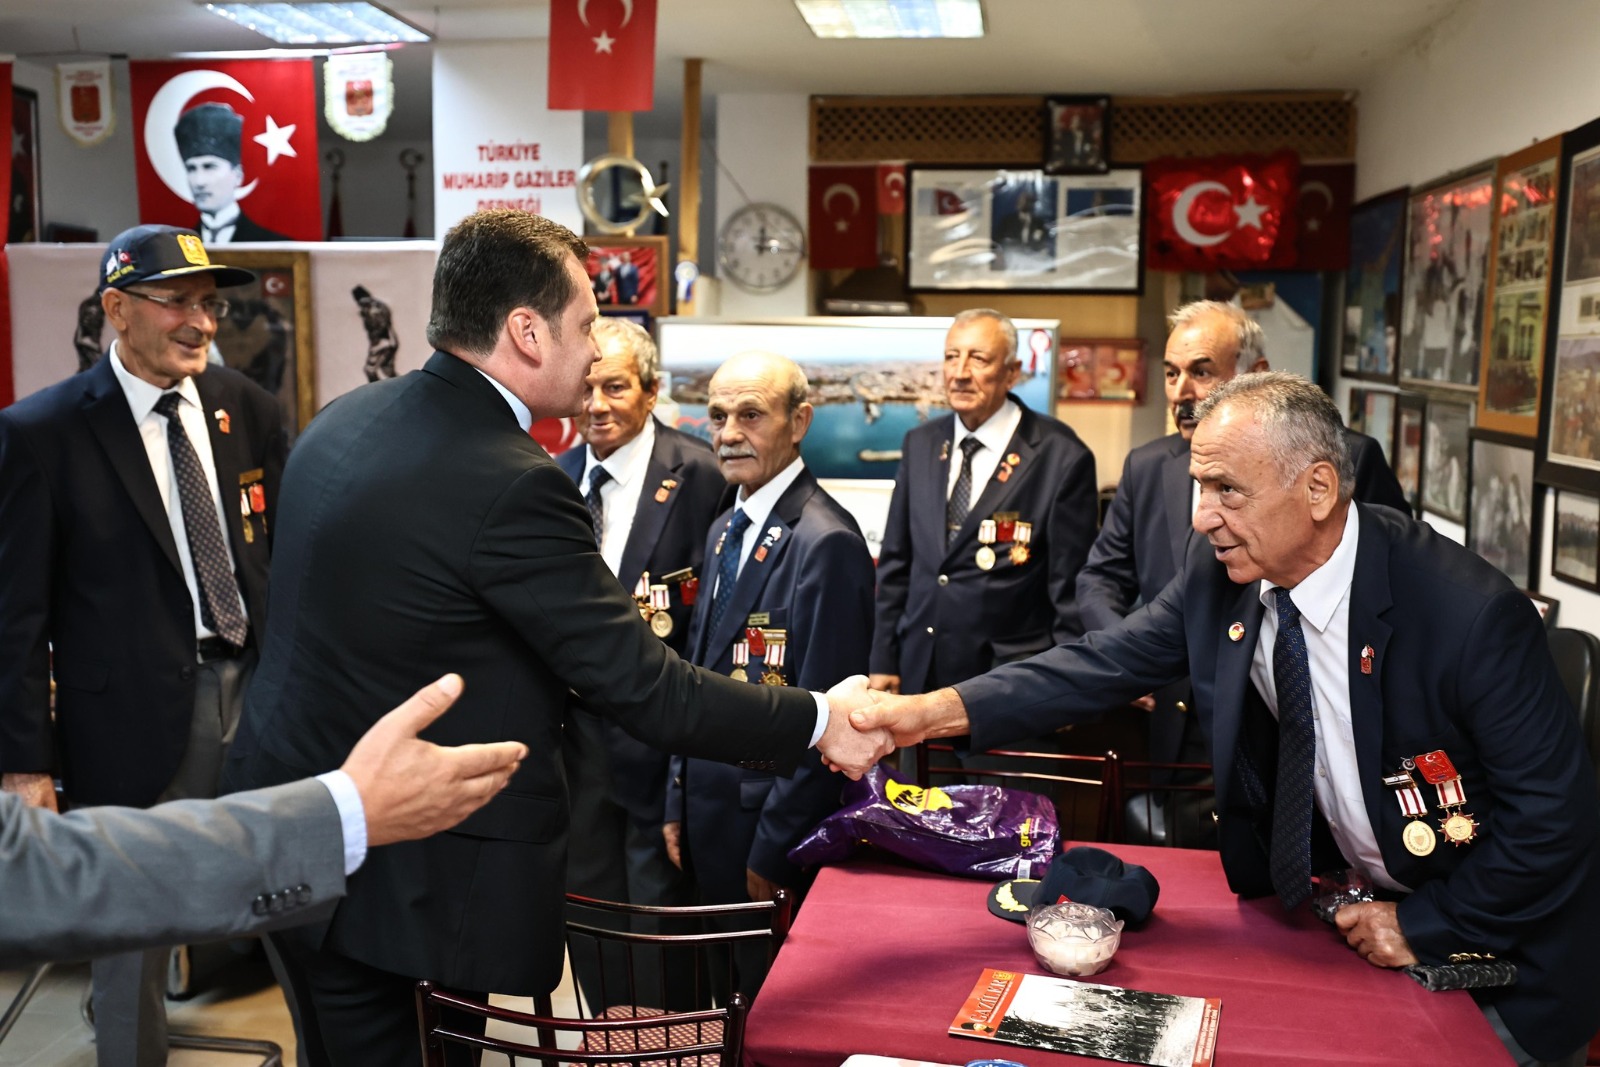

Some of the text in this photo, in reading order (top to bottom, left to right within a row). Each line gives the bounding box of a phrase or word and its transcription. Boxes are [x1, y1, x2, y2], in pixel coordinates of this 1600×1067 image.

[478, 139, 541, 162] TÜRKİYE
[443, 167, 576, 189] MUHARİP GAZİLER
[969, 979, 1007, 1022] GAZİLER
